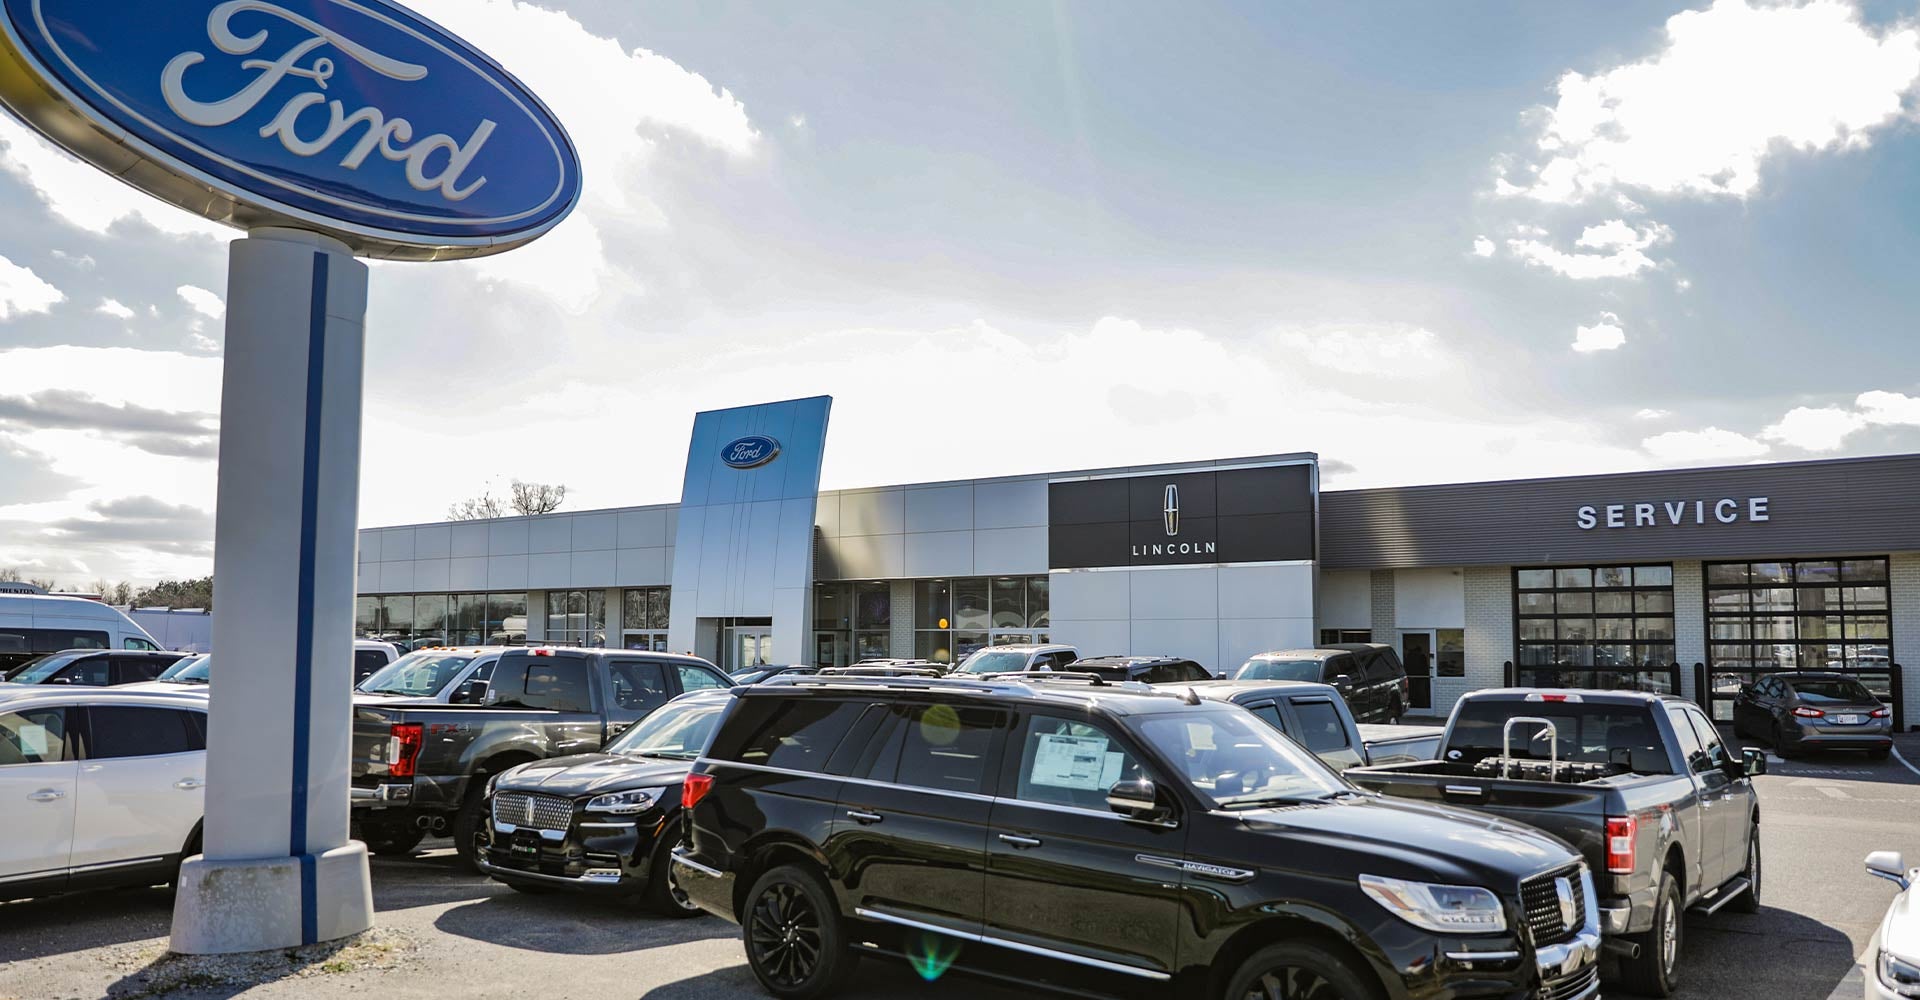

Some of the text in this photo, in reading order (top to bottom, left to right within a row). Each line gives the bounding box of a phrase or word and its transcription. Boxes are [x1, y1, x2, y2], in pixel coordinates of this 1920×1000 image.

[161, 0, 497, 201] Ford
[730, 442, 763, 461] Ford
[1577, 497, 1769, 530] SERVICE
[1132, 542, 1215, 556] LINCOLN
[431, 723, 471, 734] FX4
[1183, 863, 1236, 876] NAVIGATOR
